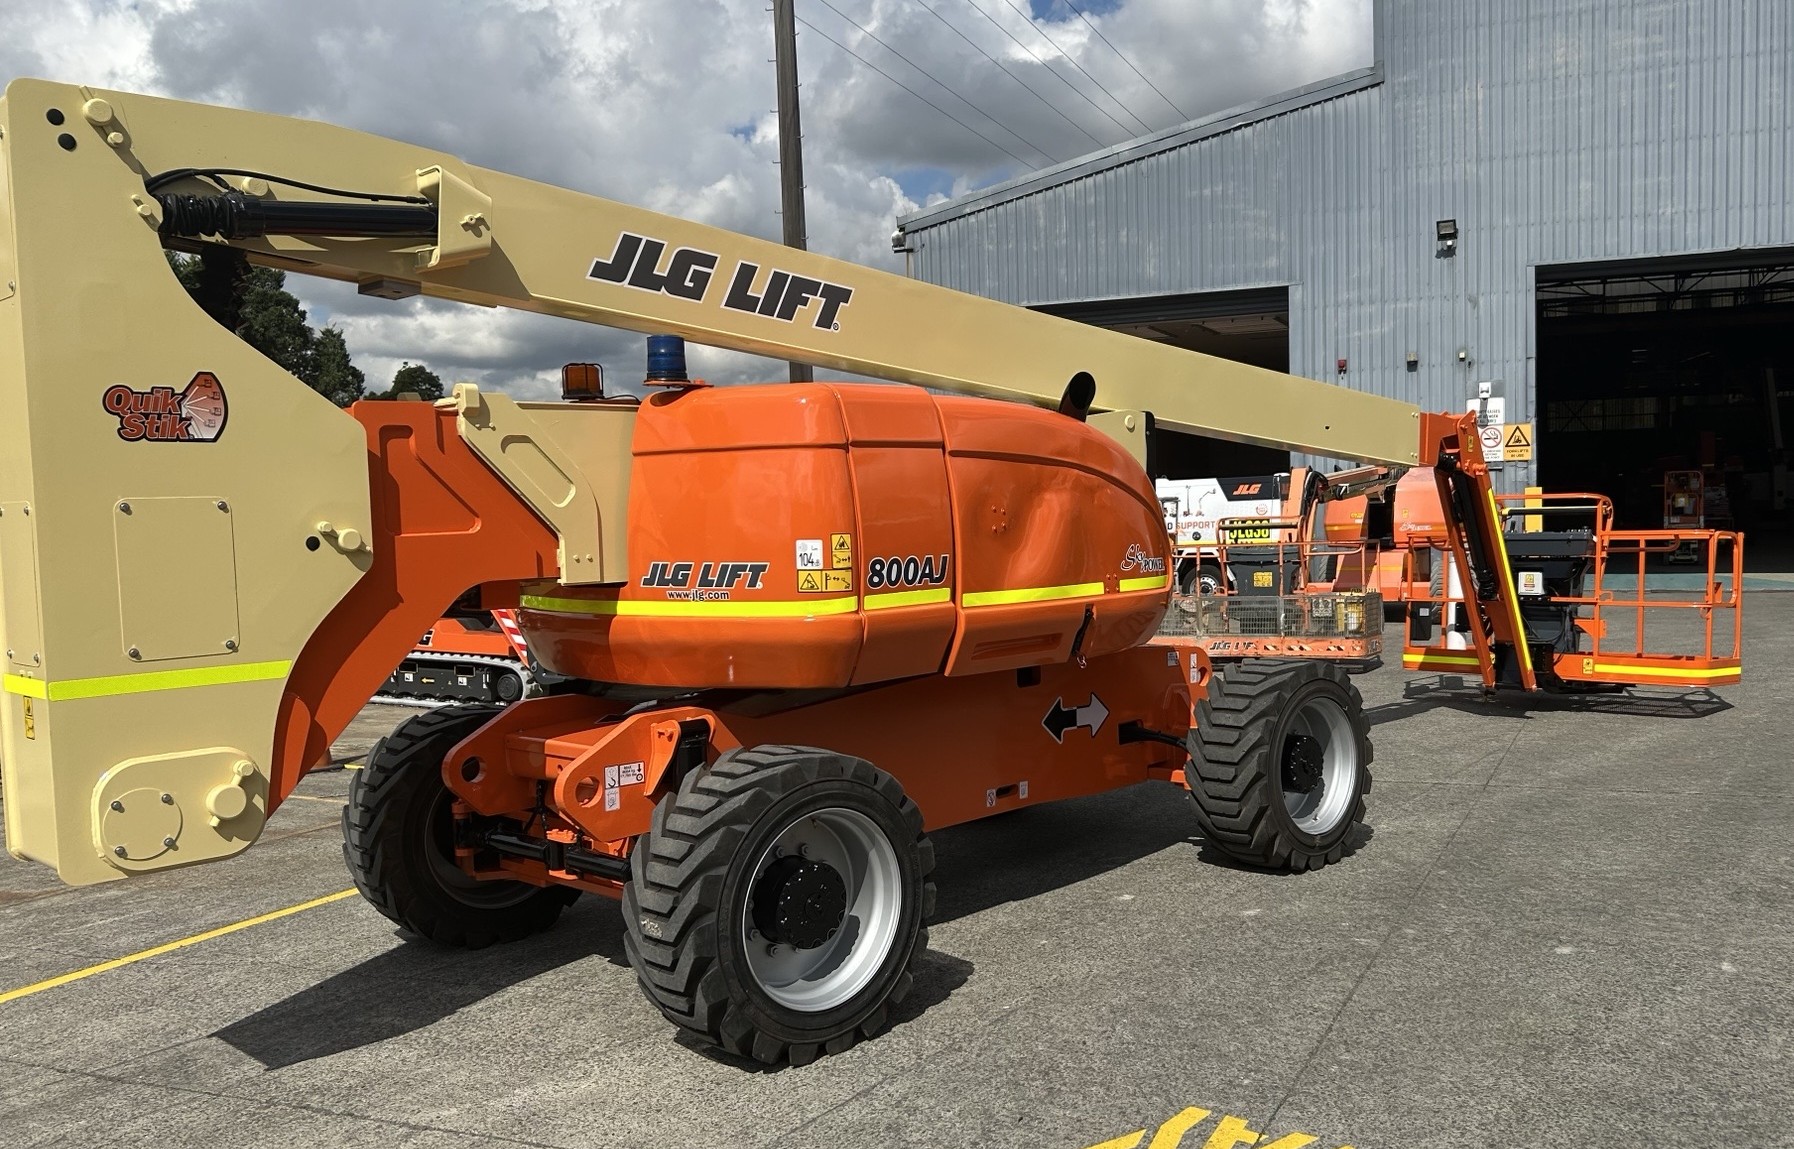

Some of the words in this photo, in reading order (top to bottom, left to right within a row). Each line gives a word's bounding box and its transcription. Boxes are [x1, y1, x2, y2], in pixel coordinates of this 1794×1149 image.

[586, 231, 720, 303] JLG
[721, 260, 854, 330] LIFT
[106, 387, 182, 416] Quik
[121, 413, 189, 439] Stik
[1233, 484, 1262, 495] JLG
[1176, 520, 1215, 531] SUPPORT
[799, 553, 815, 567] 104
[867, 554, 949, 590] 800AJ
[640, 562, 694, 588] JLG
[696, 562, 769, 588] LIFT
[667, 589, 730, 602] www.jlg.com
